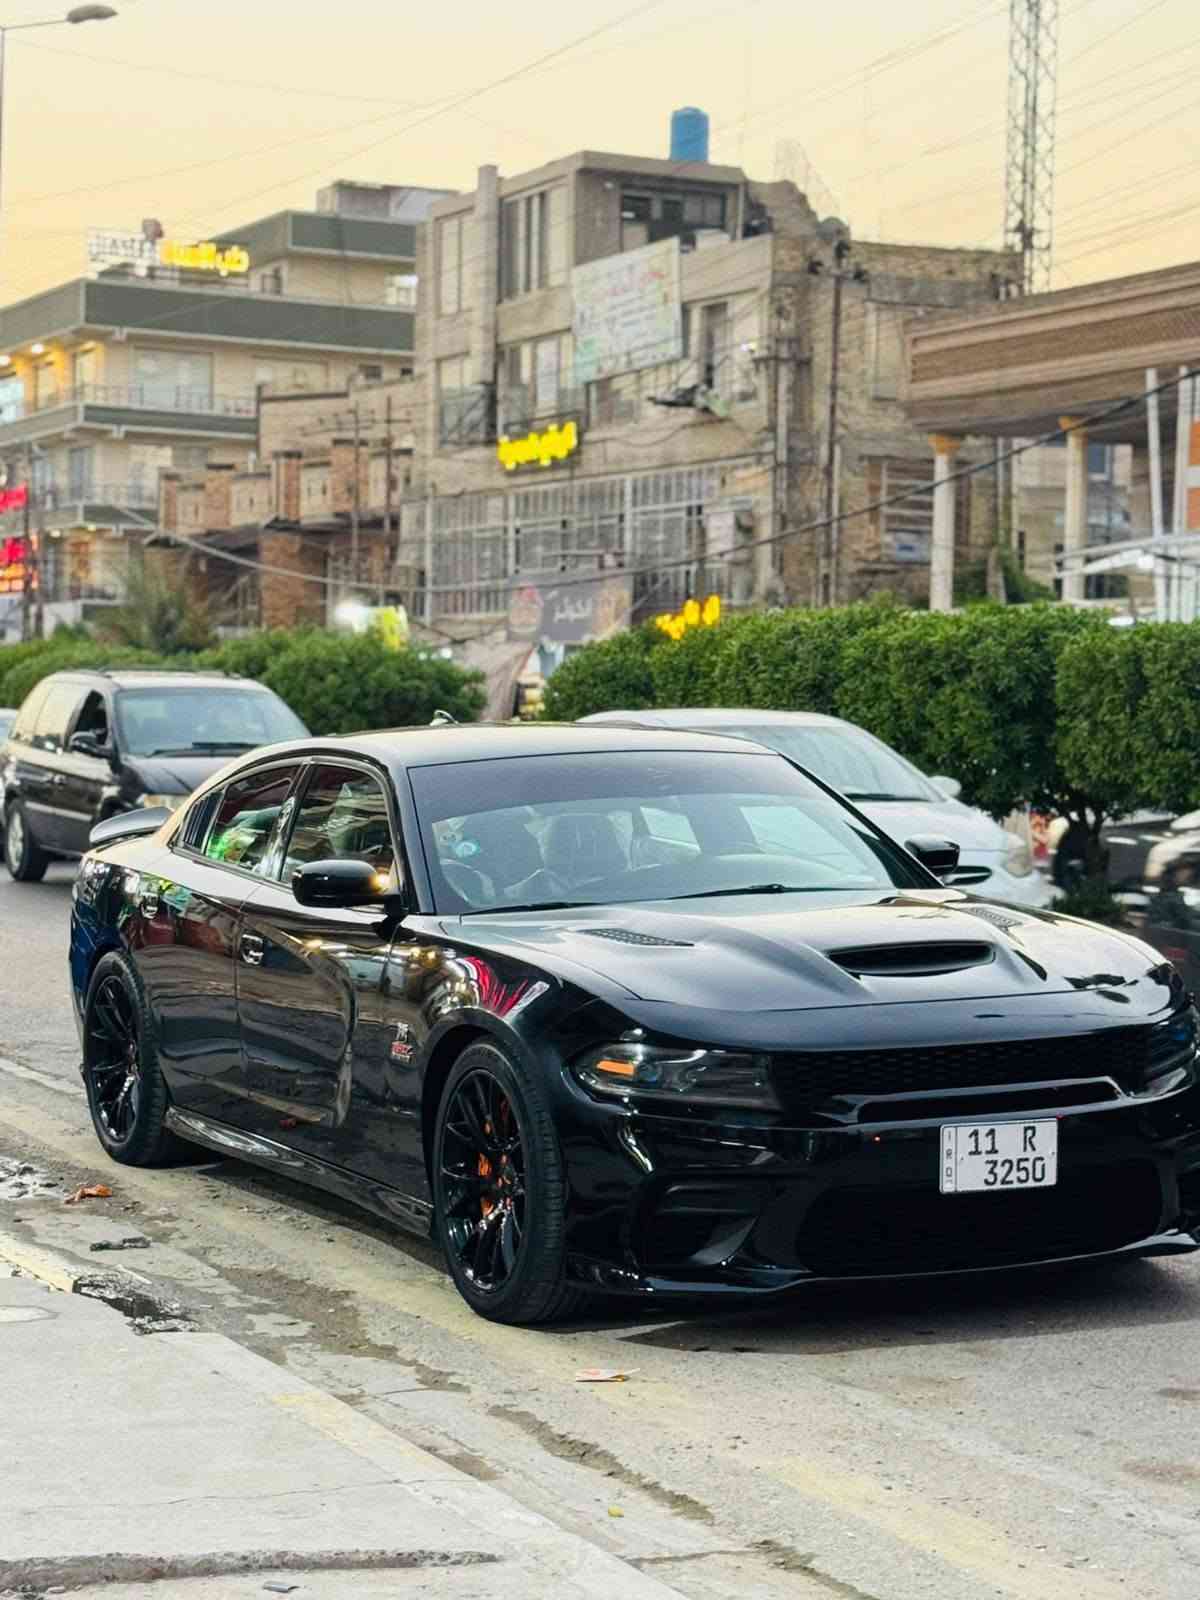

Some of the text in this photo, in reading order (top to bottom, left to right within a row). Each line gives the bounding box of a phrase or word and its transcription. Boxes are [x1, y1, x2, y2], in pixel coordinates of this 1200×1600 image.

[968, 1125, 1036, 1156] 11 R
[983, 1156, 1046, 1187] 3250
